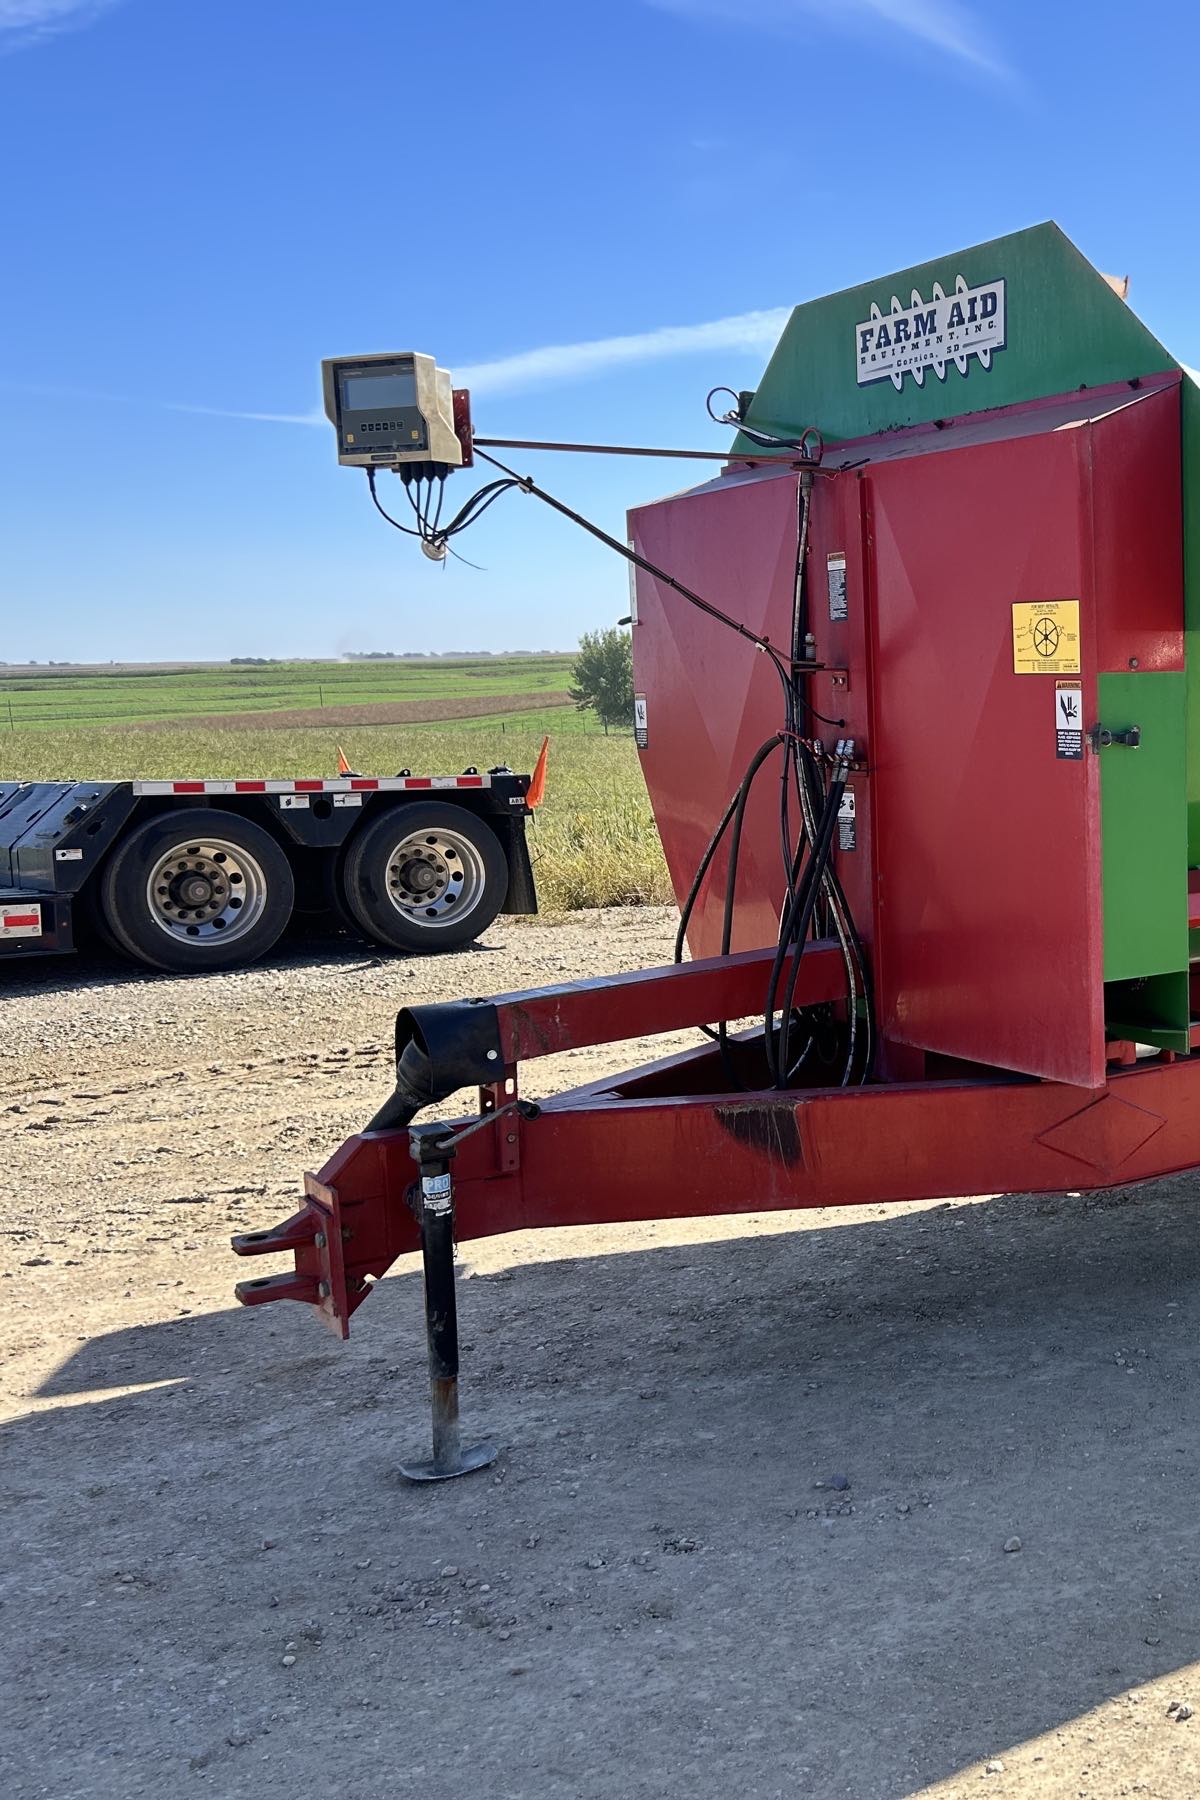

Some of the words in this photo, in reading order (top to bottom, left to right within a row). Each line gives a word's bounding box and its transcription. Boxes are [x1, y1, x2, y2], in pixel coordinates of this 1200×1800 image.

[860, 308, 937, 354] FARM
[947, 291, 998, 329] AID
[861, 331, 960, 365] EQUIPMENT,
[965, 320, 997, 336] INC.
[946, 343, 961, 354] SD
[426, 1177, 449, 1192] PRO
